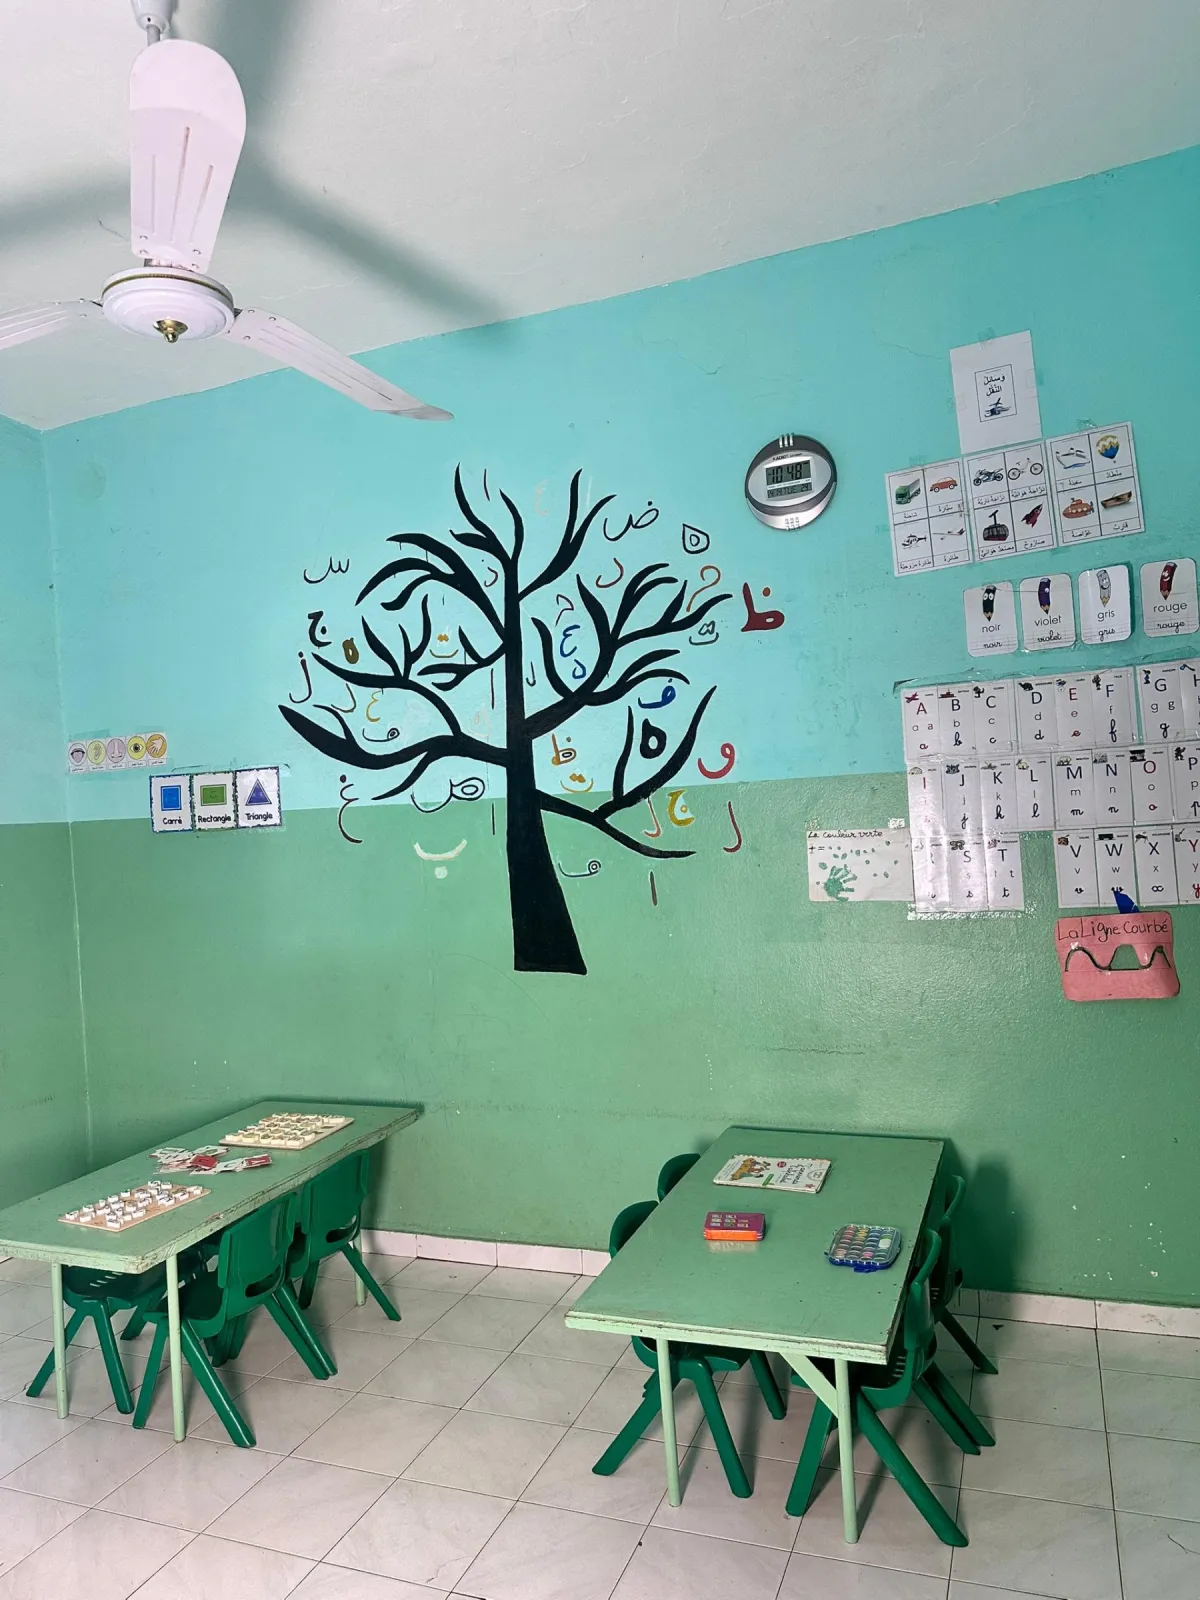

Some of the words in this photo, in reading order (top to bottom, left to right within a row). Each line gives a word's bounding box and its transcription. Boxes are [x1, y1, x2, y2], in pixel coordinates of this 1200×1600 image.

[304, 557, 349, 583] س
[741, 582, 785, 632] ظ
[1154, 602, 1187, 614] rouge
[1035, 615, 1062, 626] violet
[1098, 610, 1115, 622] gris
[308, 611, 332, 647] ج
[982, 623, 1001, 633] noir
[1157, 621, 1185, 633] rouge
[1037, 631, 1062, 643] violet
[1099, 627, 1116, 641] gris
[560, 624, 580, 658] ع
[1106, 684, 1115, 698] F
[1155, 679, 1167, 692] G
[638, 678, 676, 708] ف
[1032, 692, 1043, 705] D
[1069, 688, 1078, 701] E
[917, 702, 928, 715] A
[952, 699, 961, 712] B
[986, 696, 997, 709] C
[1151, 703, 1159, 713] g
[1035, 712, 1042, 721] d
[954, 719, 960, 728] b
[1035, 730, 1045, 740] d
[551, 733, 577, 765] ظ
[1106, 763, 1118, 777] N
[1144, 760, 1156, 774] O
[1189, 757, 1198, 771] P
[994, 772, 1003, 785] K
[1031, 770, 1039, 782] L
[1067, 766, 1083, 780] M
[960, 774, 965, 787] J
[1191, 781, 1199, 791] p
[410, 777, 485, 813] ص
[1071, 788, 1081, 796] m
[1110, 786, 1116, 794] n
[668, 788, 695, 827] ج
[163, 816, 183, 826] Carré
[198, 813, 232, 823] Rectangle
[246, 812, 273, 821] Triangle
[1071, 845, 1082, 858] V
[1106, 843, 1123, 857] W
[1149, 842, 1160, 855] X
[1189, 839, 1199, 853] Y
[414, 839, 467, 879] ب
[964, 851, 972, 863] S
[998, 849, 1008, 862] T
[1058, 920, 1079, 941] La
[1081, 918, 1121, 942] Ligne
[1124, 919, 1169, 933] Courbé
